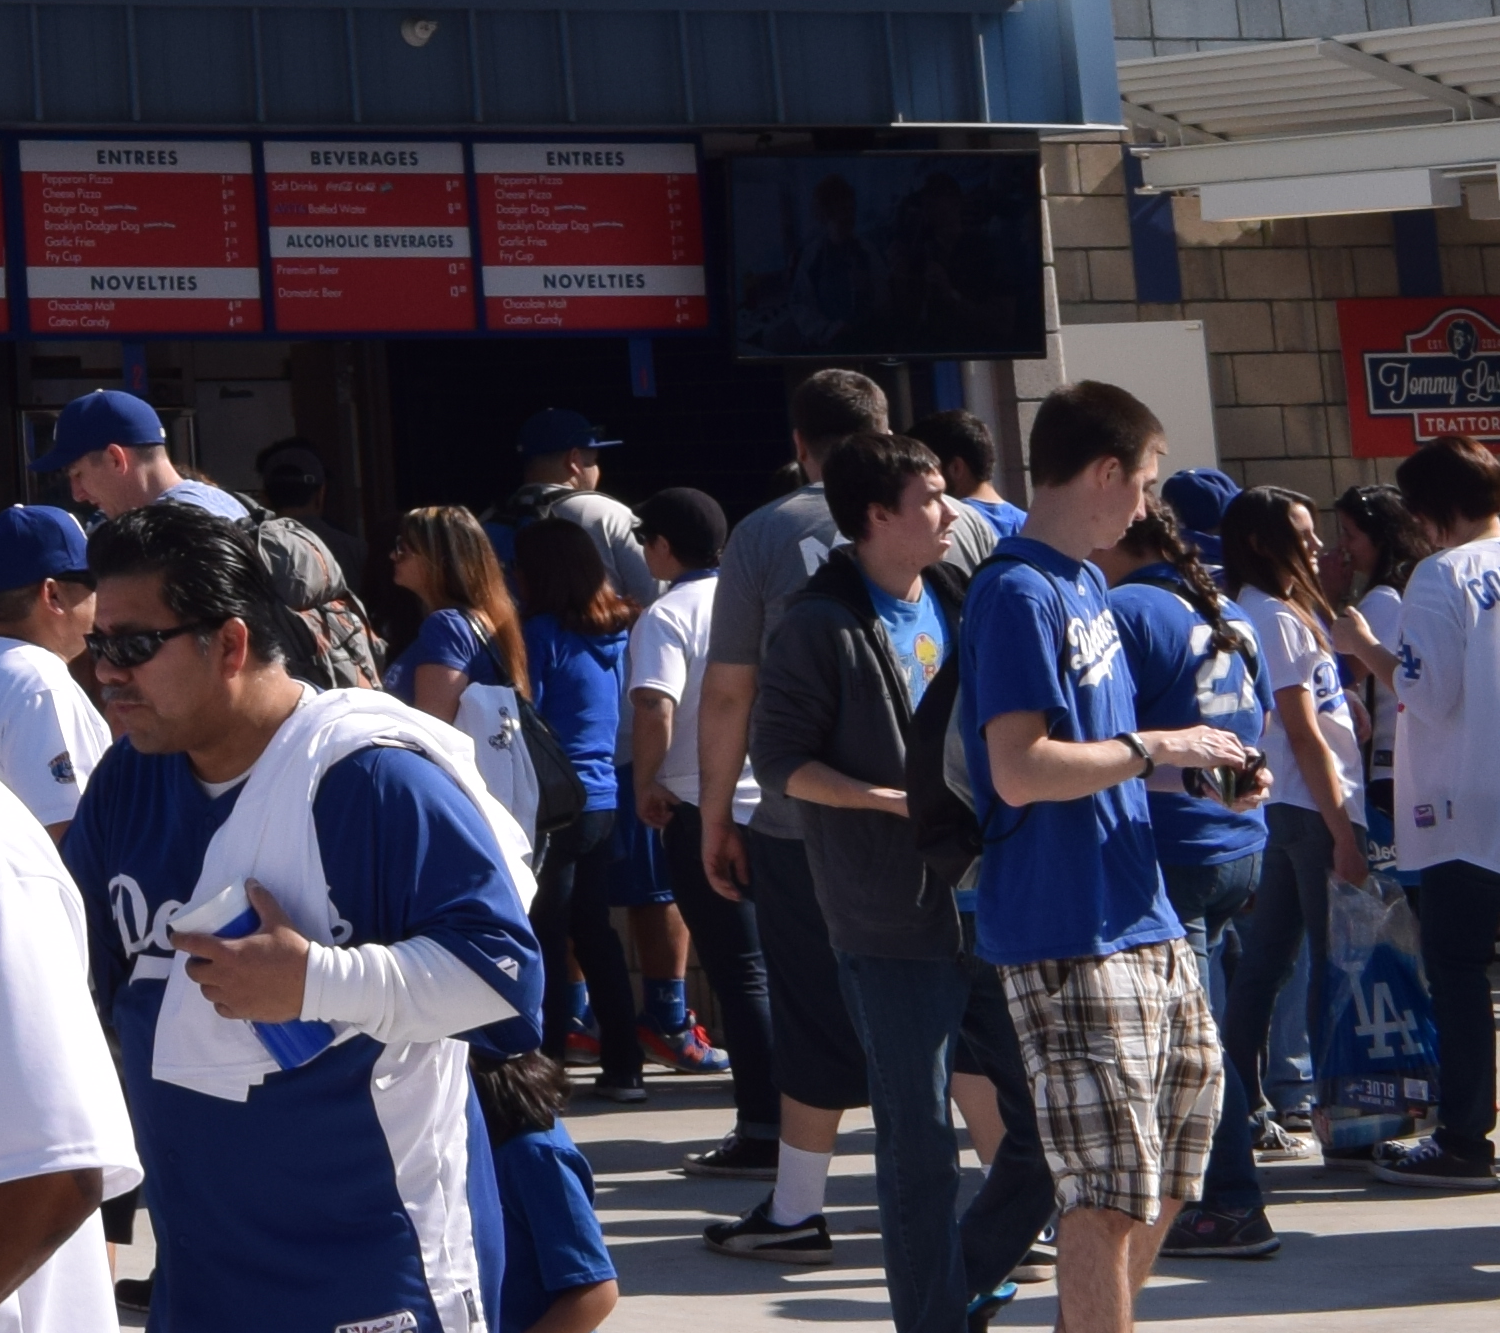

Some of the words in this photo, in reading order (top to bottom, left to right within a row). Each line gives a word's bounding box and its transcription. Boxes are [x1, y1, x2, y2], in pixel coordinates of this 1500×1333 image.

[96, 148, 178, 165] ENTREES
[309, 149, 418, 166] BEVERAGES
[545, 150, 625, 166] ENTREES
[285, 233, 369, 248] ALCOHOLIC
[373, 233, 453, 248] BEVERAGES
[90, 274, 197, 291] NOVELTIES
[541, 272, 646, 291] NOVELTIES
[1378, 362, 1458, 405] Tommy
